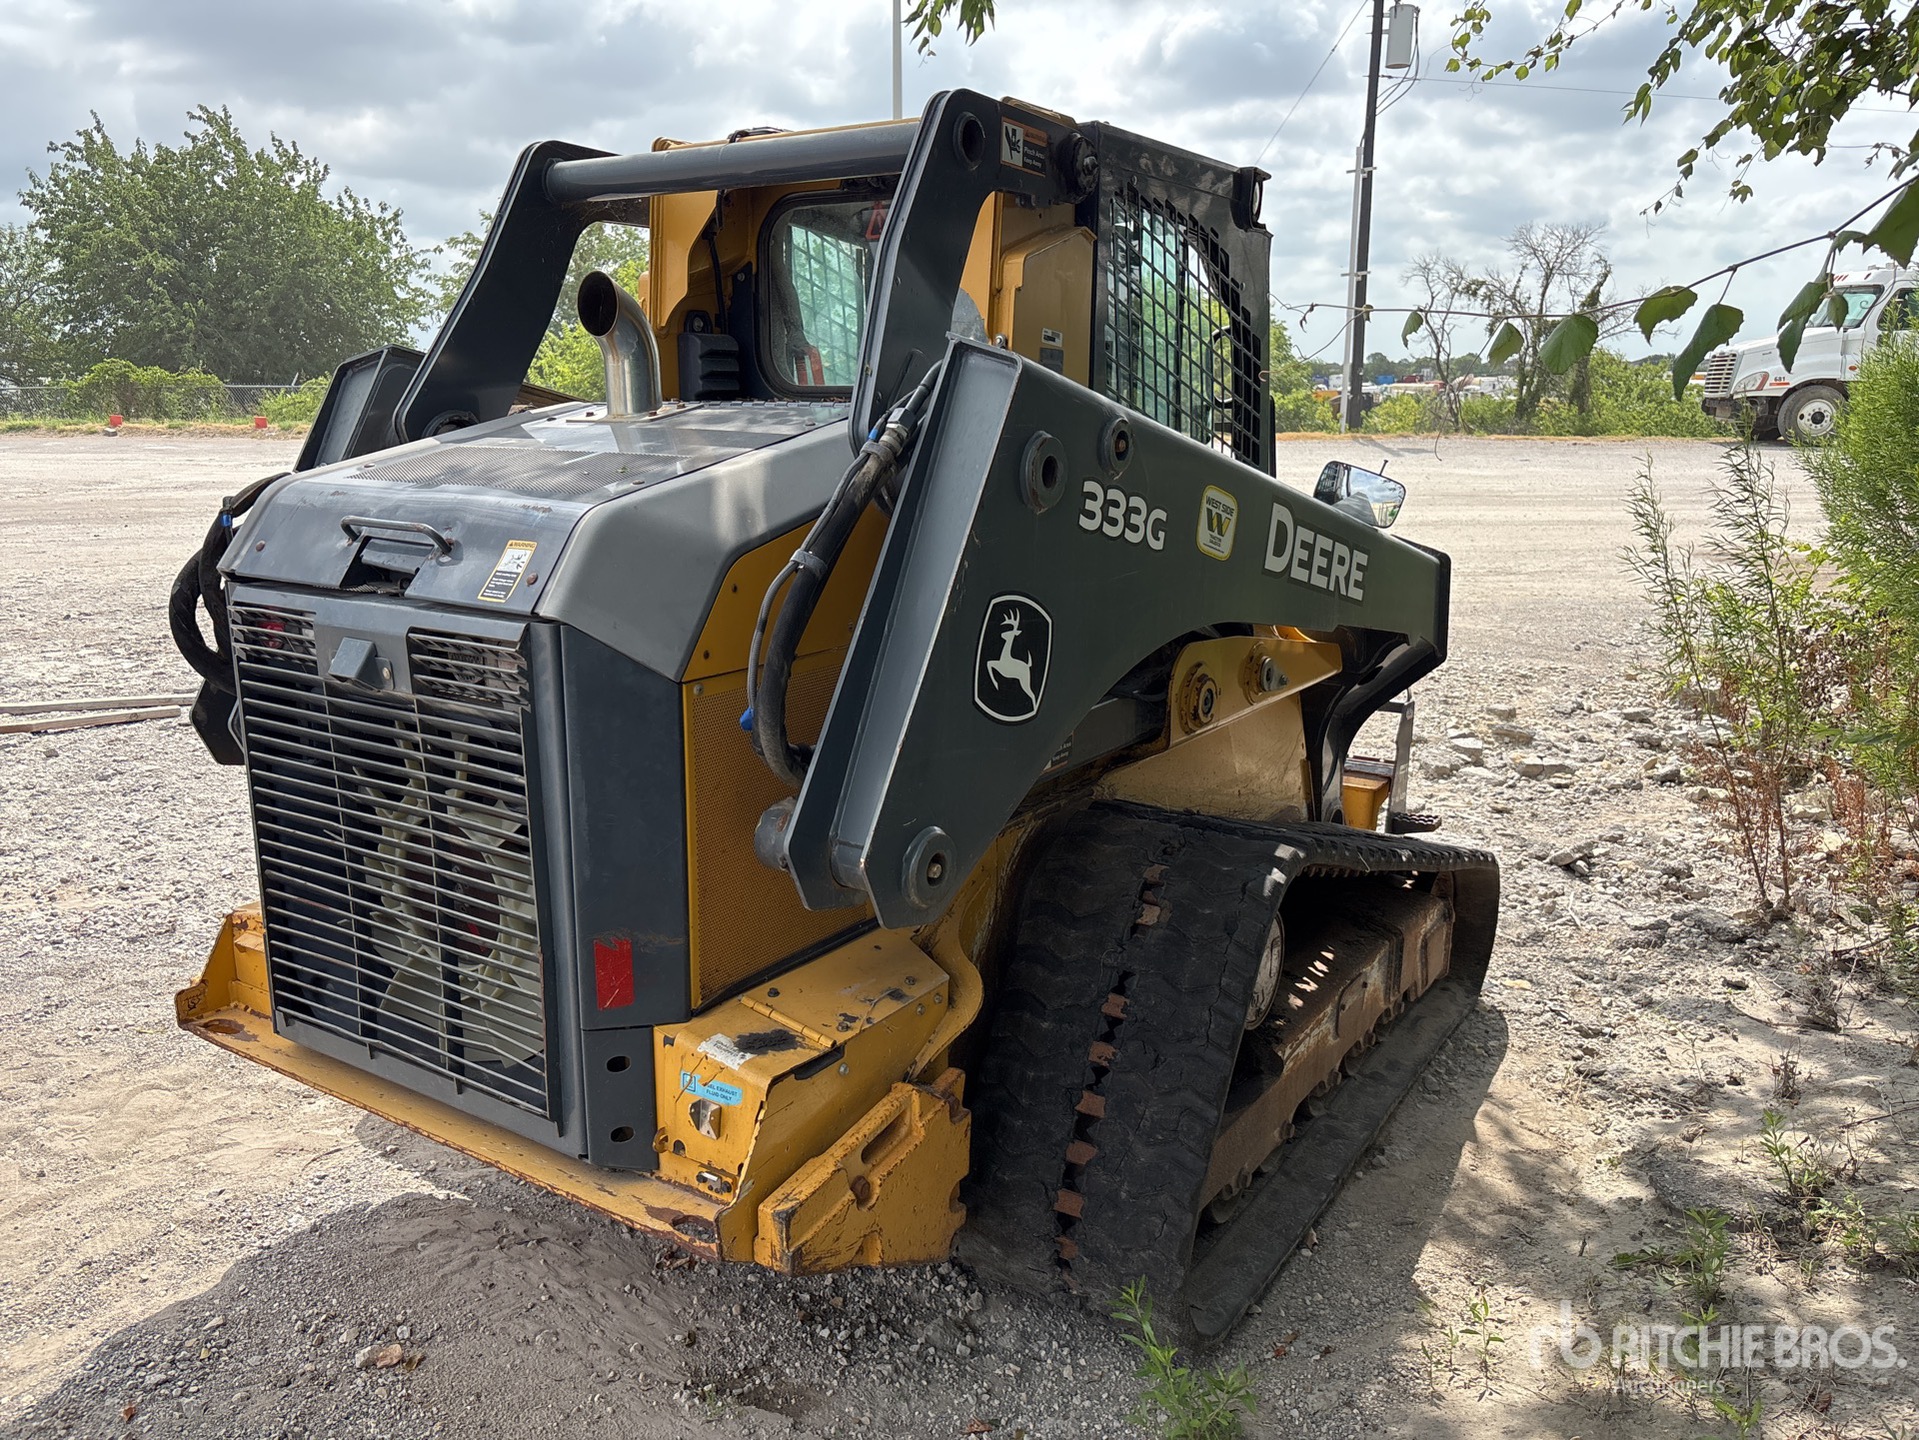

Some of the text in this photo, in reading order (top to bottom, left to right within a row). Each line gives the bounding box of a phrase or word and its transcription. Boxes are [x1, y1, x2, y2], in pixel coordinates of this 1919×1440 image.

[1079, 480, 1168, 551] 333G
[1205, 495, 1235, 517] WEST SIDE
[1206, 507, 1232, 538] W
[1264, 502, 1369, 602] DEERE
[706, 1089, 733, 1101] FLUID ONLY
[716, 1085, 738, 1097] EXHAUST
